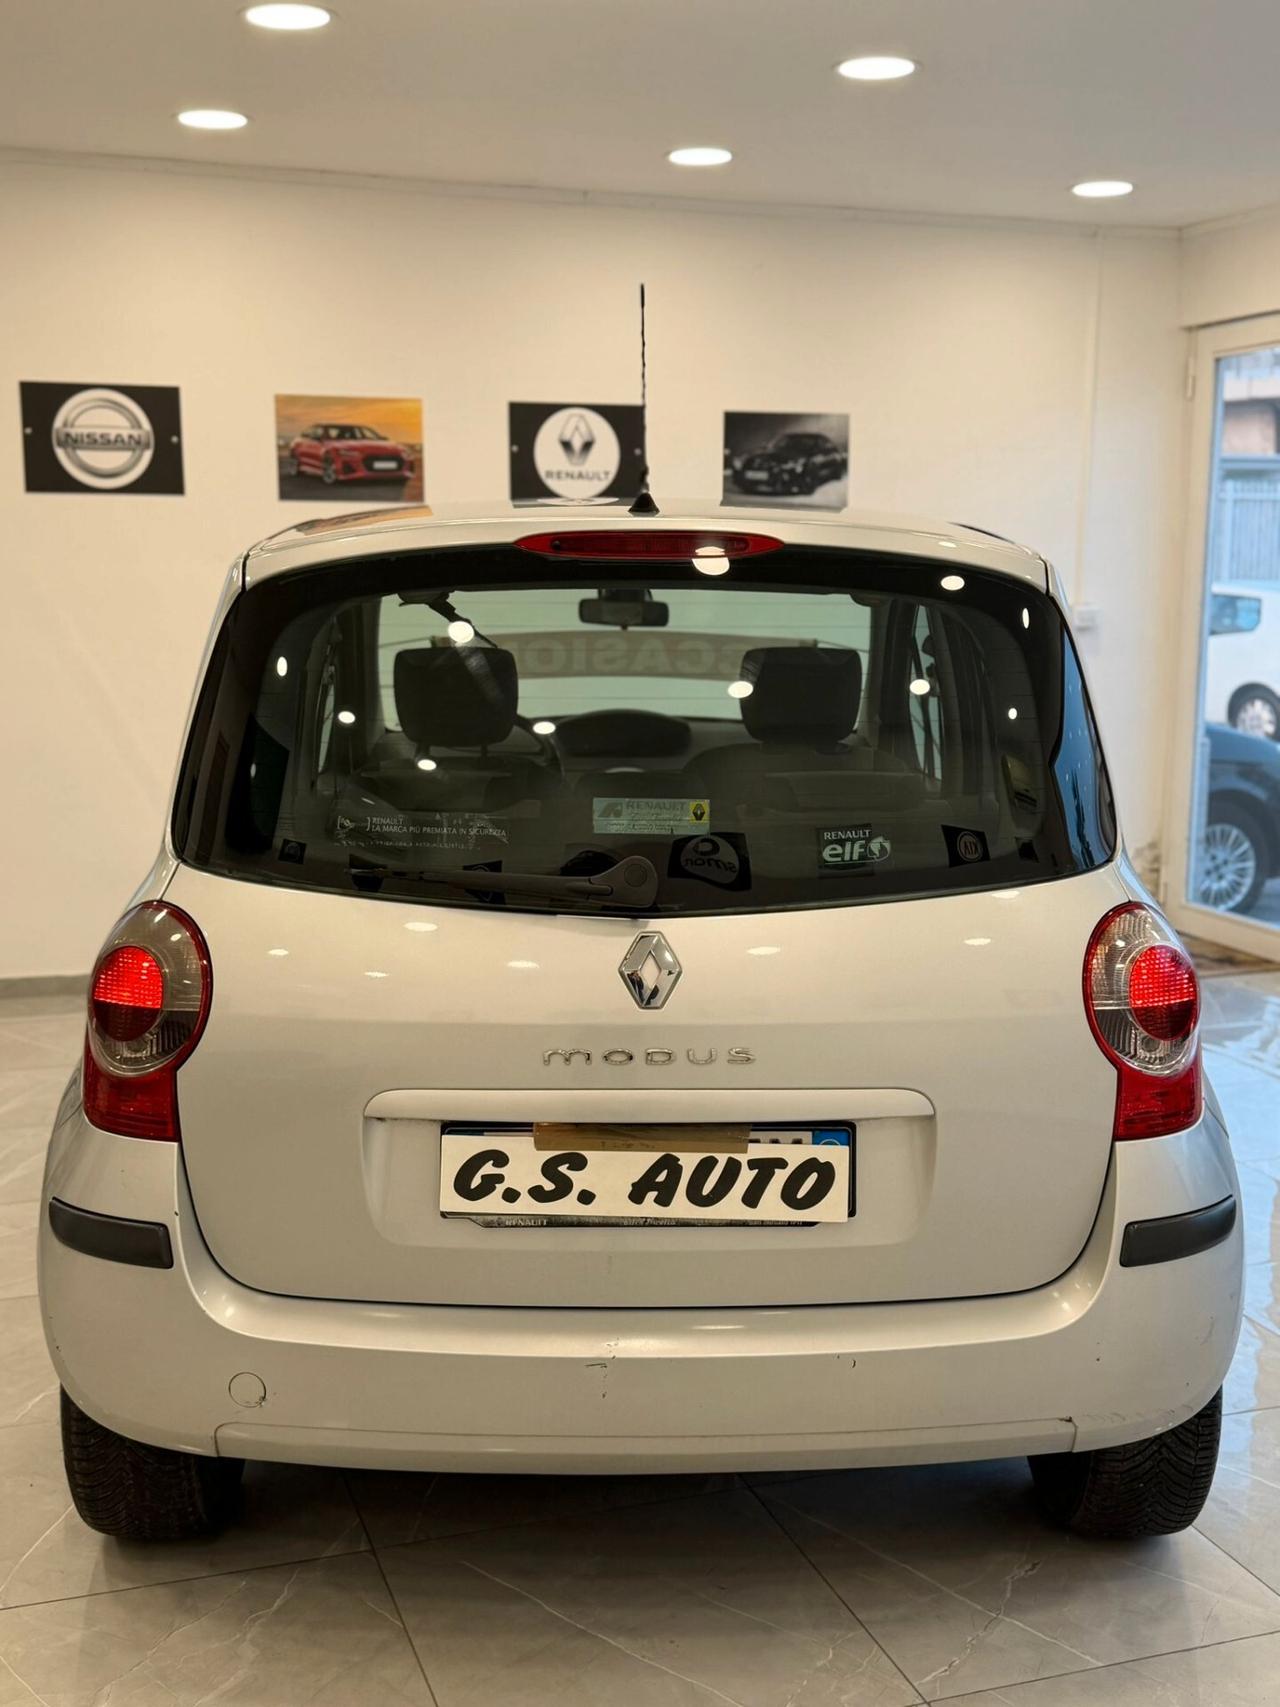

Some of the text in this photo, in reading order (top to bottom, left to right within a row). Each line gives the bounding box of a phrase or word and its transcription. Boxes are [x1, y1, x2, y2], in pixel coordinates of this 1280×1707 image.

[64, 431, 142, 447] NISSAN
[544, 470, 611, 482] RENAULT
[625, 800, 687, 811] RENAULT
[371, 816, 404, 826] RENAULT
[371, 824, 381, 832] LA
[383, 825, 408, 833] MARCA
[823, 829, 872, 840] RENAULT
[822, 840, 866, 863] elf
[453, 1149, 837, 1210] G.S. AUTO
